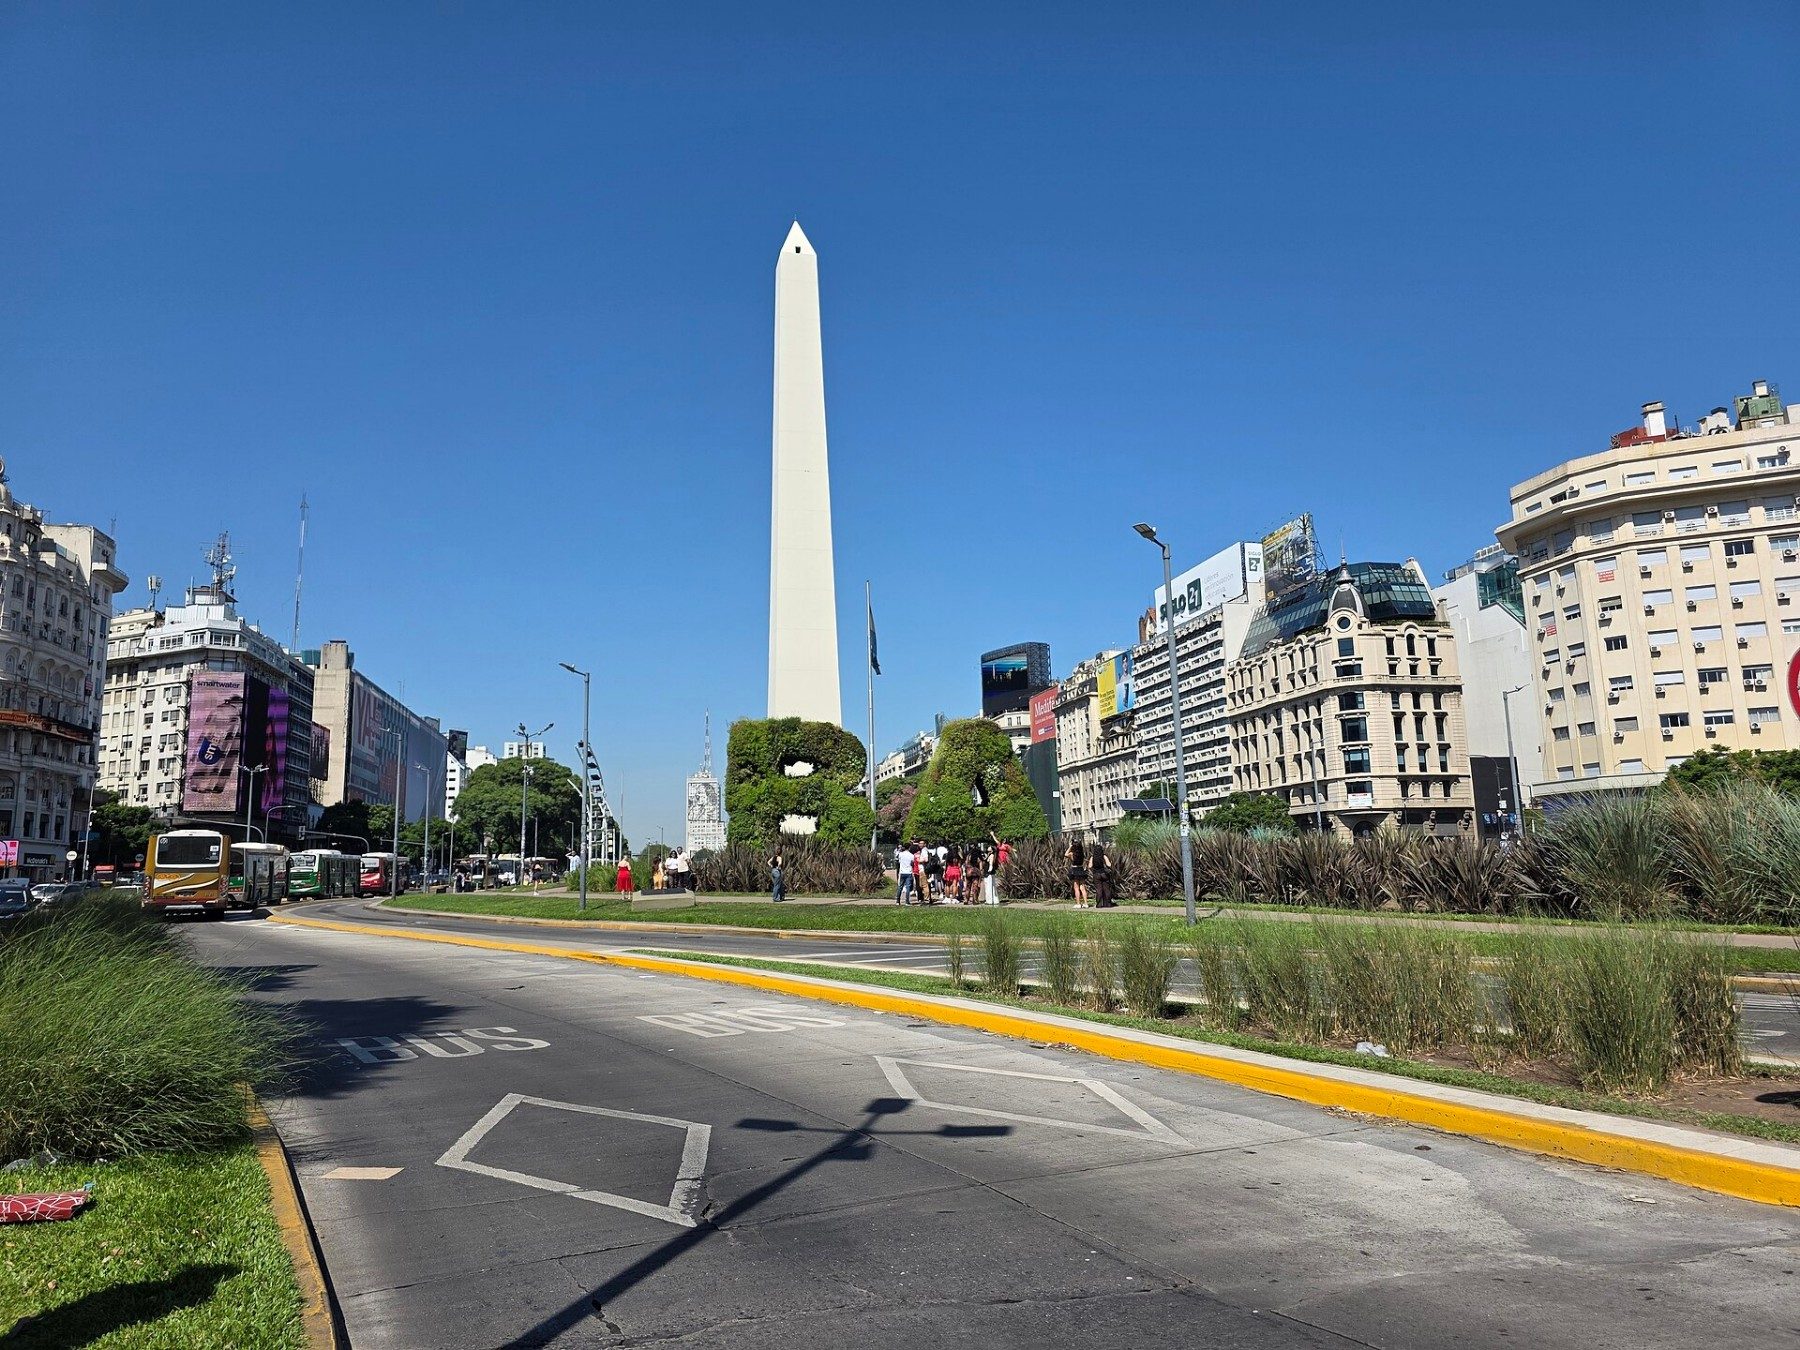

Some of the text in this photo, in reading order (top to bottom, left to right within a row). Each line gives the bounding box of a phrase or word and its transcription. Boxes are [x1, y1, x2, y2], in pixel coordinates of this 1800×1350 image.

[26, 857, 48, 865] McDonald's
[635, 1006, 847, 1037] BUS
[335, 1027, 551, 1063] BUS
